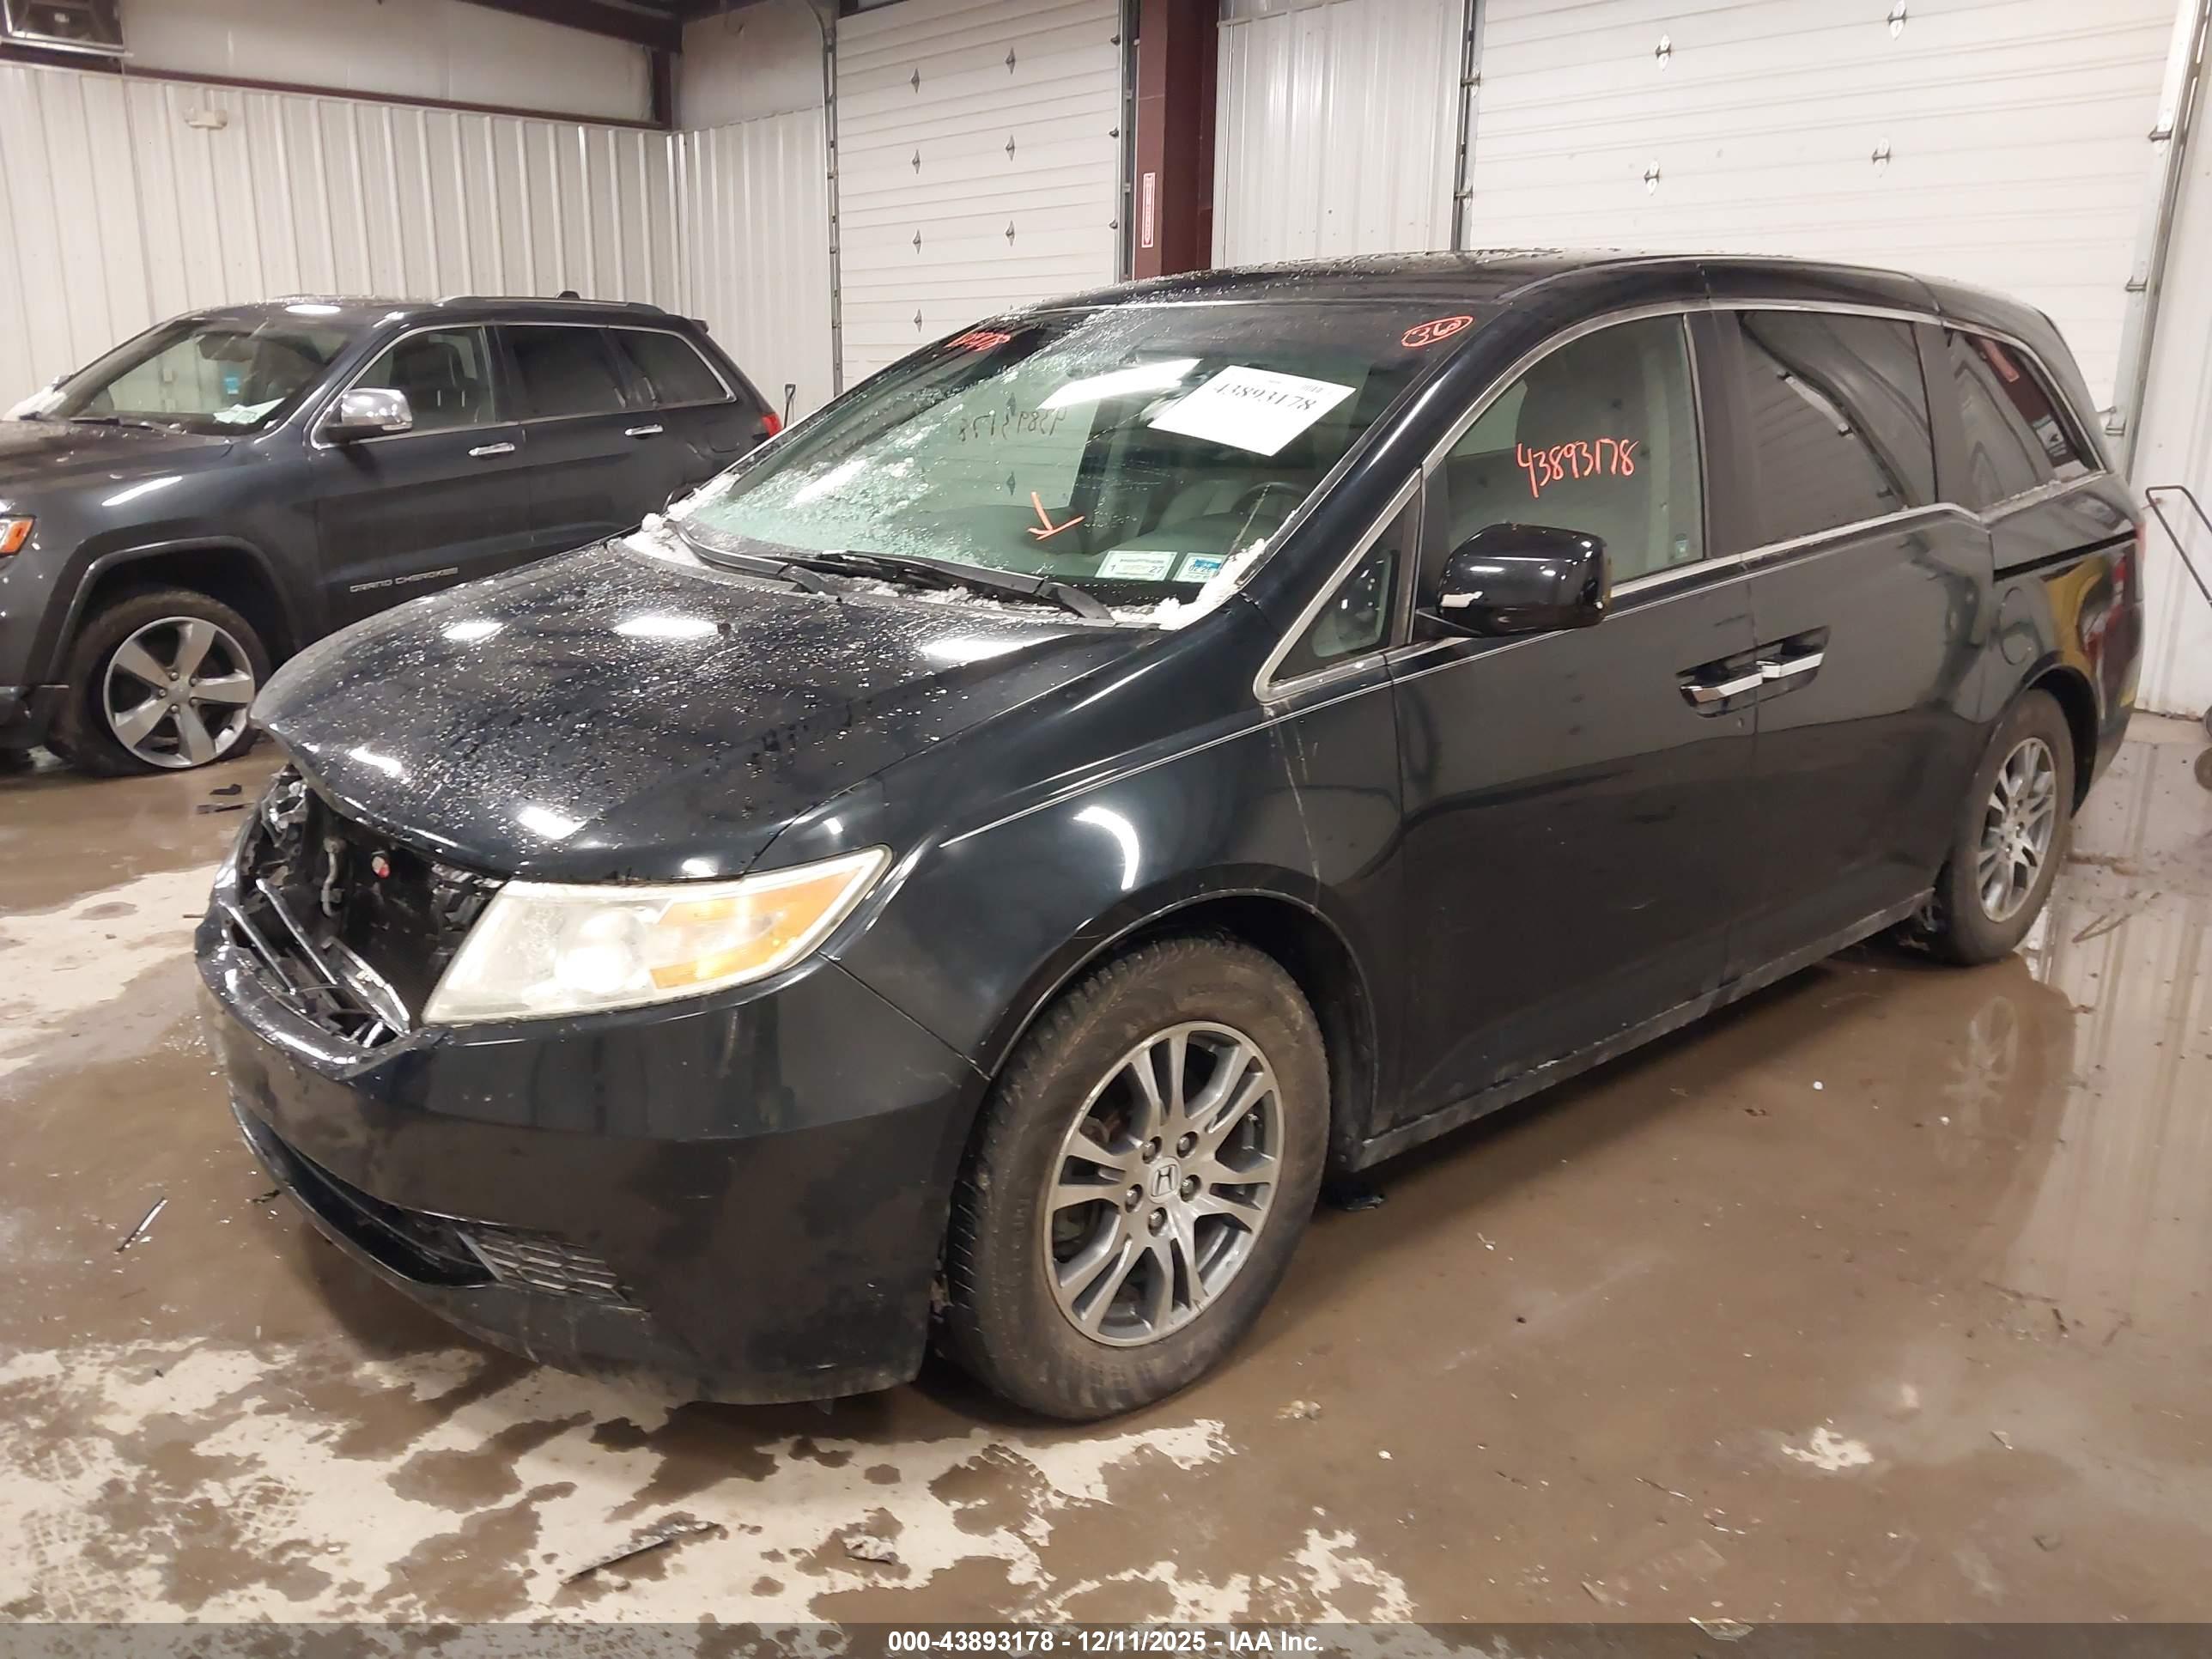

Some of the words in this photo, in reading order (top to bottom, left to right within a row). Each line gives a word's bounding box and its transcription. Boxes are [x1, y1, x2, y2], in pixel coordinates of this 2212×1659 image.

[1213, 383, 1317, 410] 43893178
[1516, 437, 1640, 499] 43893178
[349, 579, 392, 592] GRAND
[395, 567, 458, 584] CHEROKEE
